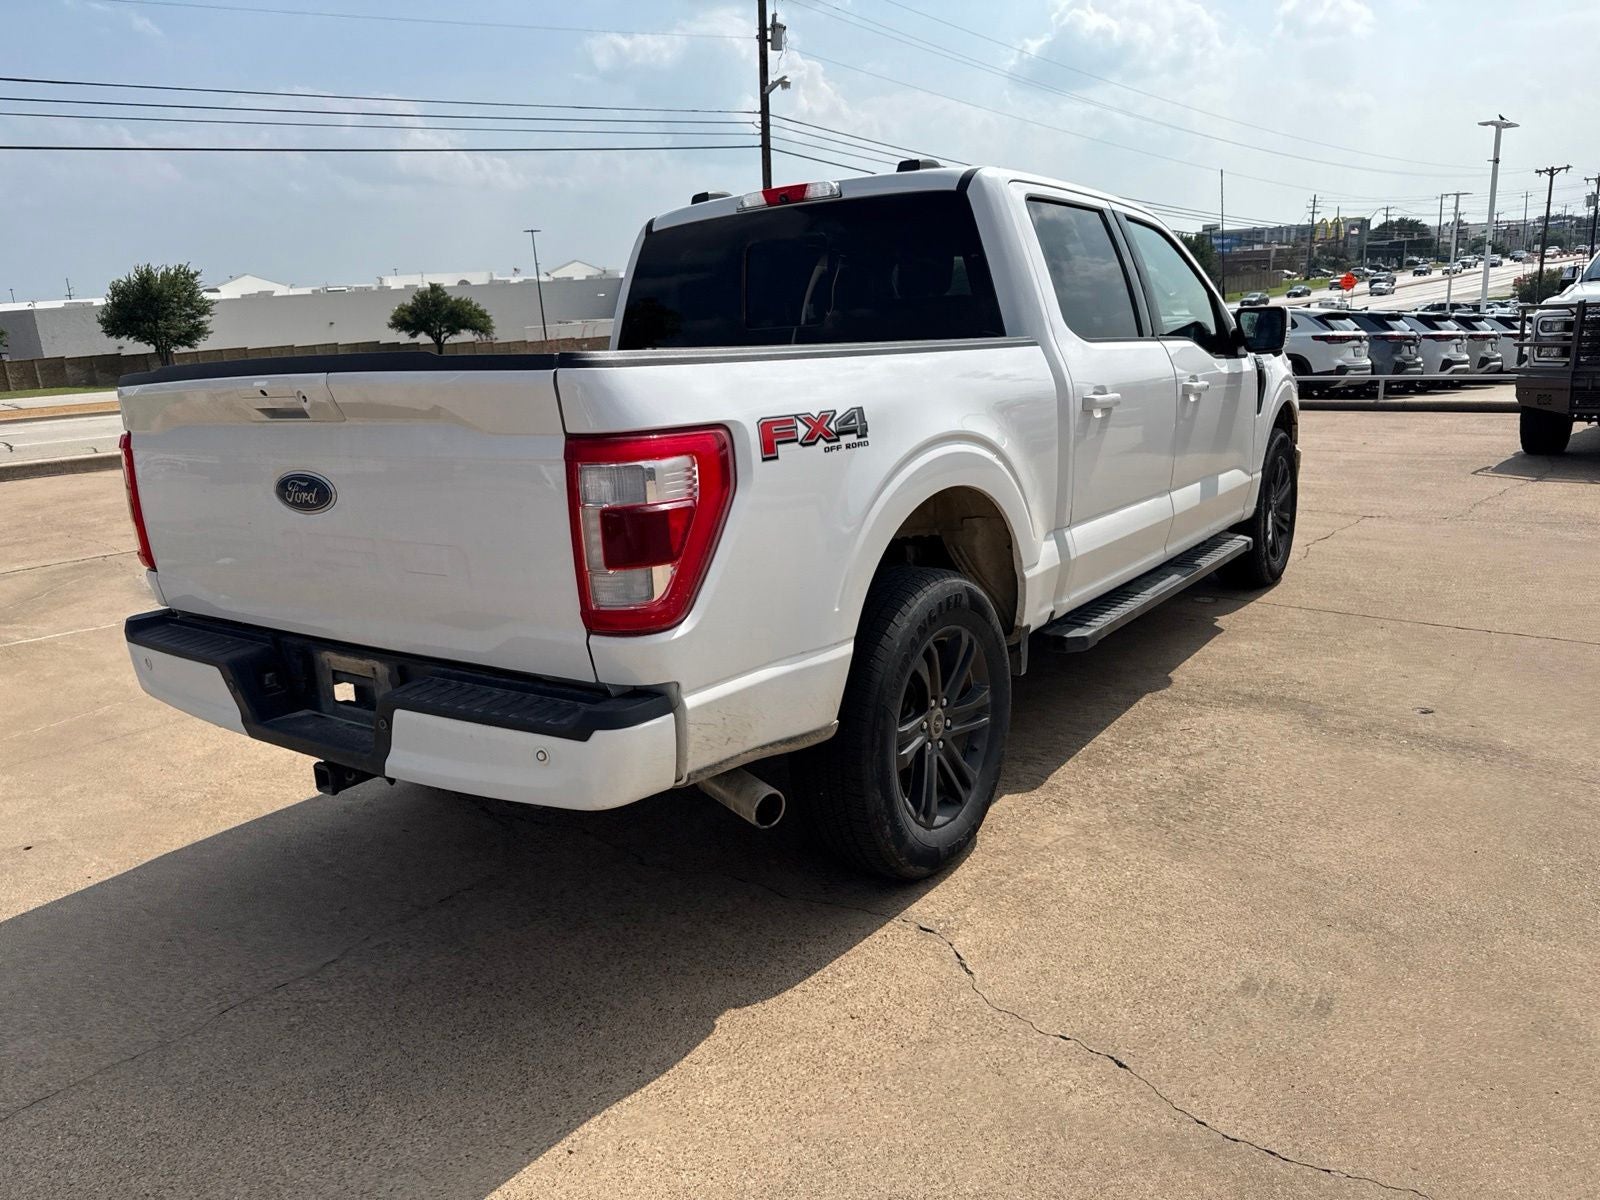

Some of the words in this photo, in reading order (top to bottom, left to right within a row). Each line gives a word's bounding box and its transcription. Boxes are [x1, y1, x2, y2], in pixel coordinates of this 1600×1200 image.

[757, 406, 868, 462] FX4
[824, 445, 842, 453] OFF
[845, 440, 869, 450] ROAD
[285, 480, 318, 504] Ford
